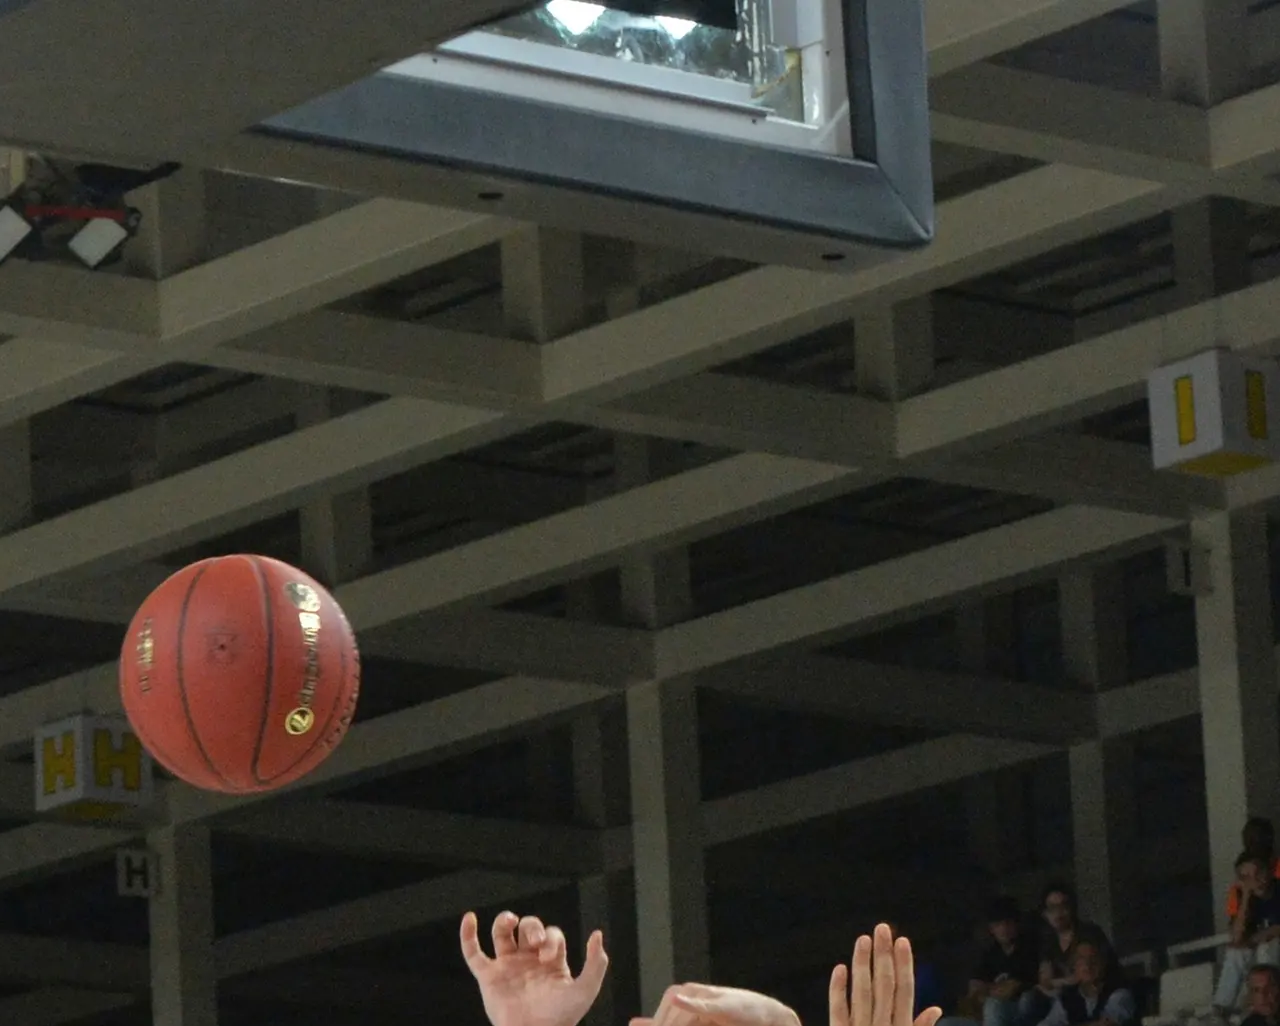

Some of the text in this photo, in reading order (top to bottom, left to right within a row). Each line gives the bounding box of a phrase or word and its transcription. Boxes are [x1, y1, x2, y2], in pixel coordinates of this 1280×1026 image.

[43, 730, 76, 796] H
[93, 729, 142, 792] H
[125, 855, 149, 889] H
